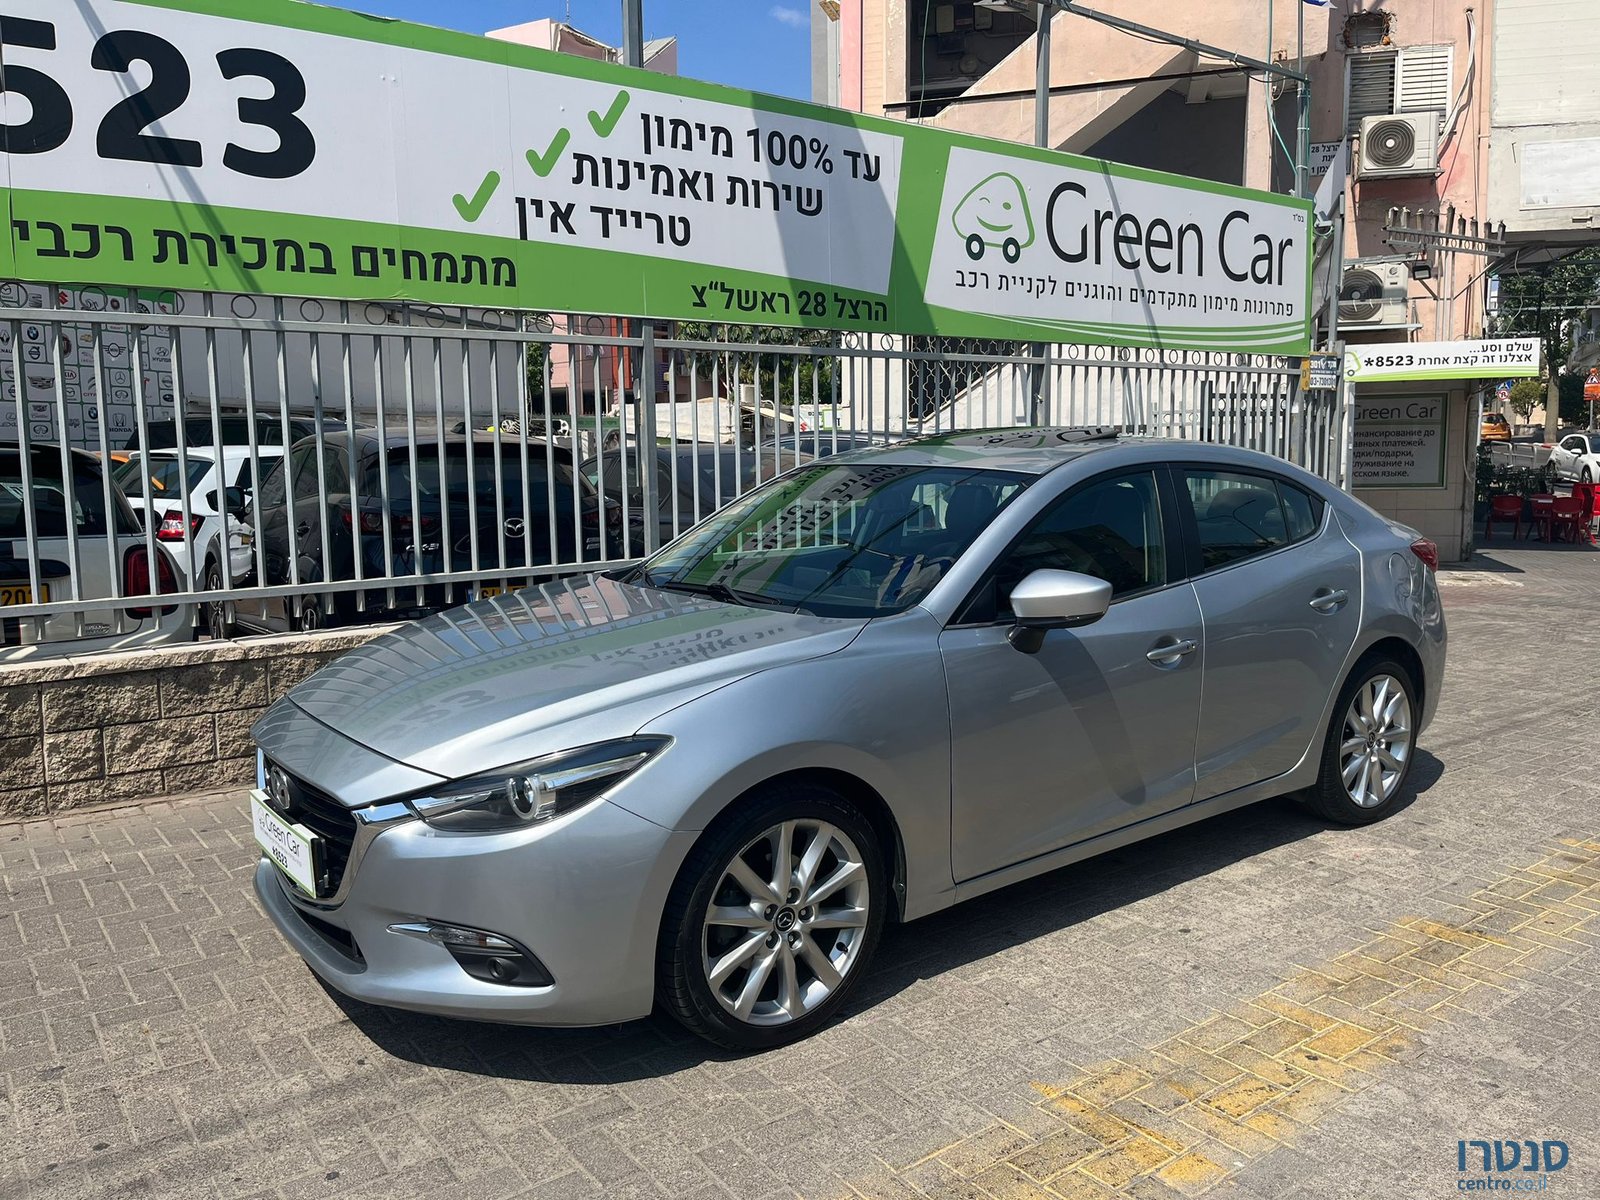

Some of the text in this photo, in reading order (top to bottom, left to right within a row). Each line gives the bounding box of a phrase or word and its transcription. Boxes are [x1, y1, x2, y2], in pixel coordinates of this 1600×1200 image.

[641, 112, 881, 182] עד 100% מימון
[571, 152, 823, 217] שירות ואמינות
[515, 196, 691, 247] טרייד אין
[1046, 181, 1293, 286] Green Car
[12, 218, 518, 288] מתמחים במכירת רכבי
[798, 290, 826, 317] 28
[833, 292, 888, 323] הרצל
[956, 269, 1294, 317] פתרונות מימון מתקדמים והוגנים לקניית רכב
[1418, 357, 1449, 366] אחרת
[1454, 355, 1478, 366] קצת
[1482, 354, 1495, 364] זה
[1499, 353, 1532, 363] אצלנו
[1506, 342, 1532, 352] שלם
[1406, 403, 1437, 418] Car
[1354, 430, 1435, 438] инансирование до
[265, 812, 300, 858] Green Car
